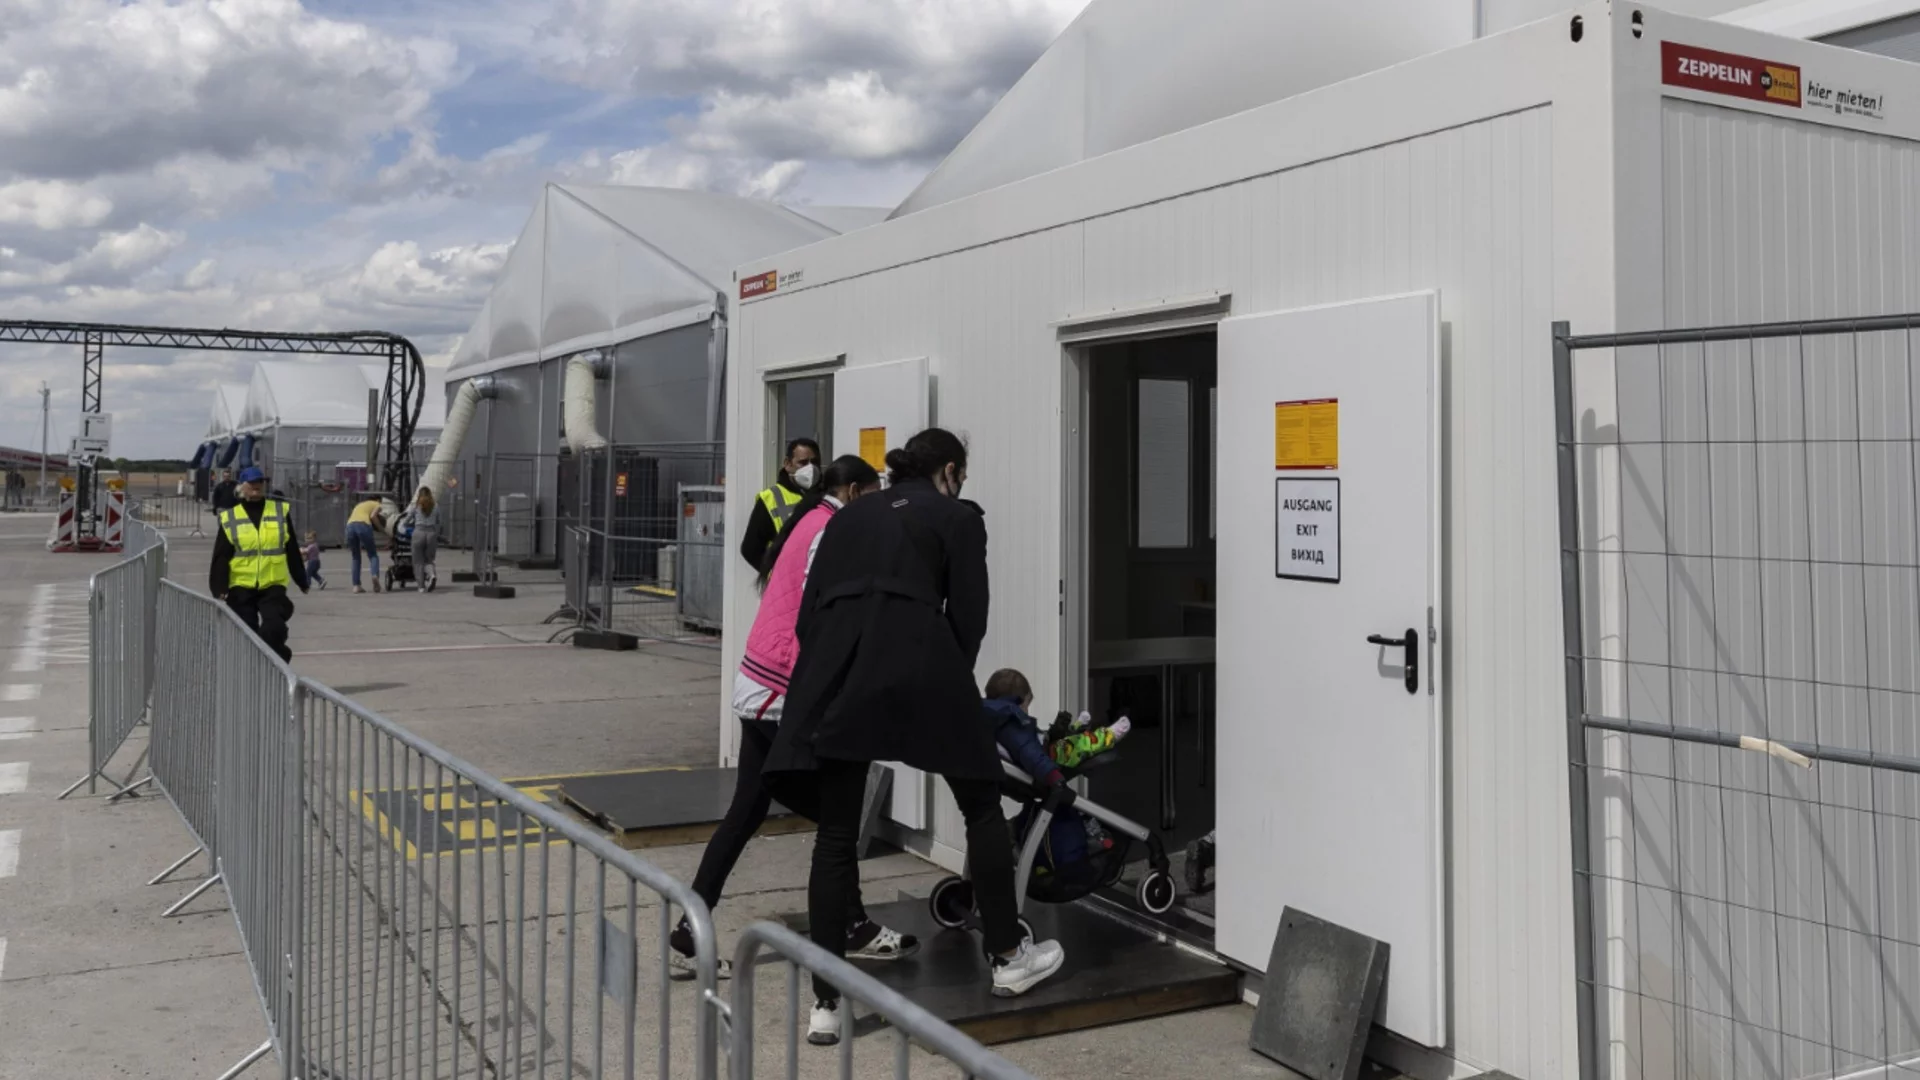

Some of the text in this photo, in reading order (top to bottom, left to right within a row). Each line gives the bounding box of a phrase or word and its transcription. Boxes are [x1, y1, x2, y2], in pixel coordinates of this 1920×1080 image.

[1678, 57, 1752, 86] ZEPPELIN
[1807, 81, 1832, 100] hier
[1283, 499, 1332, 511] AUSGANG
[1296, 524, 1318, 536] EXIT
[1291, 548, 1324, 564] ВИХІД
